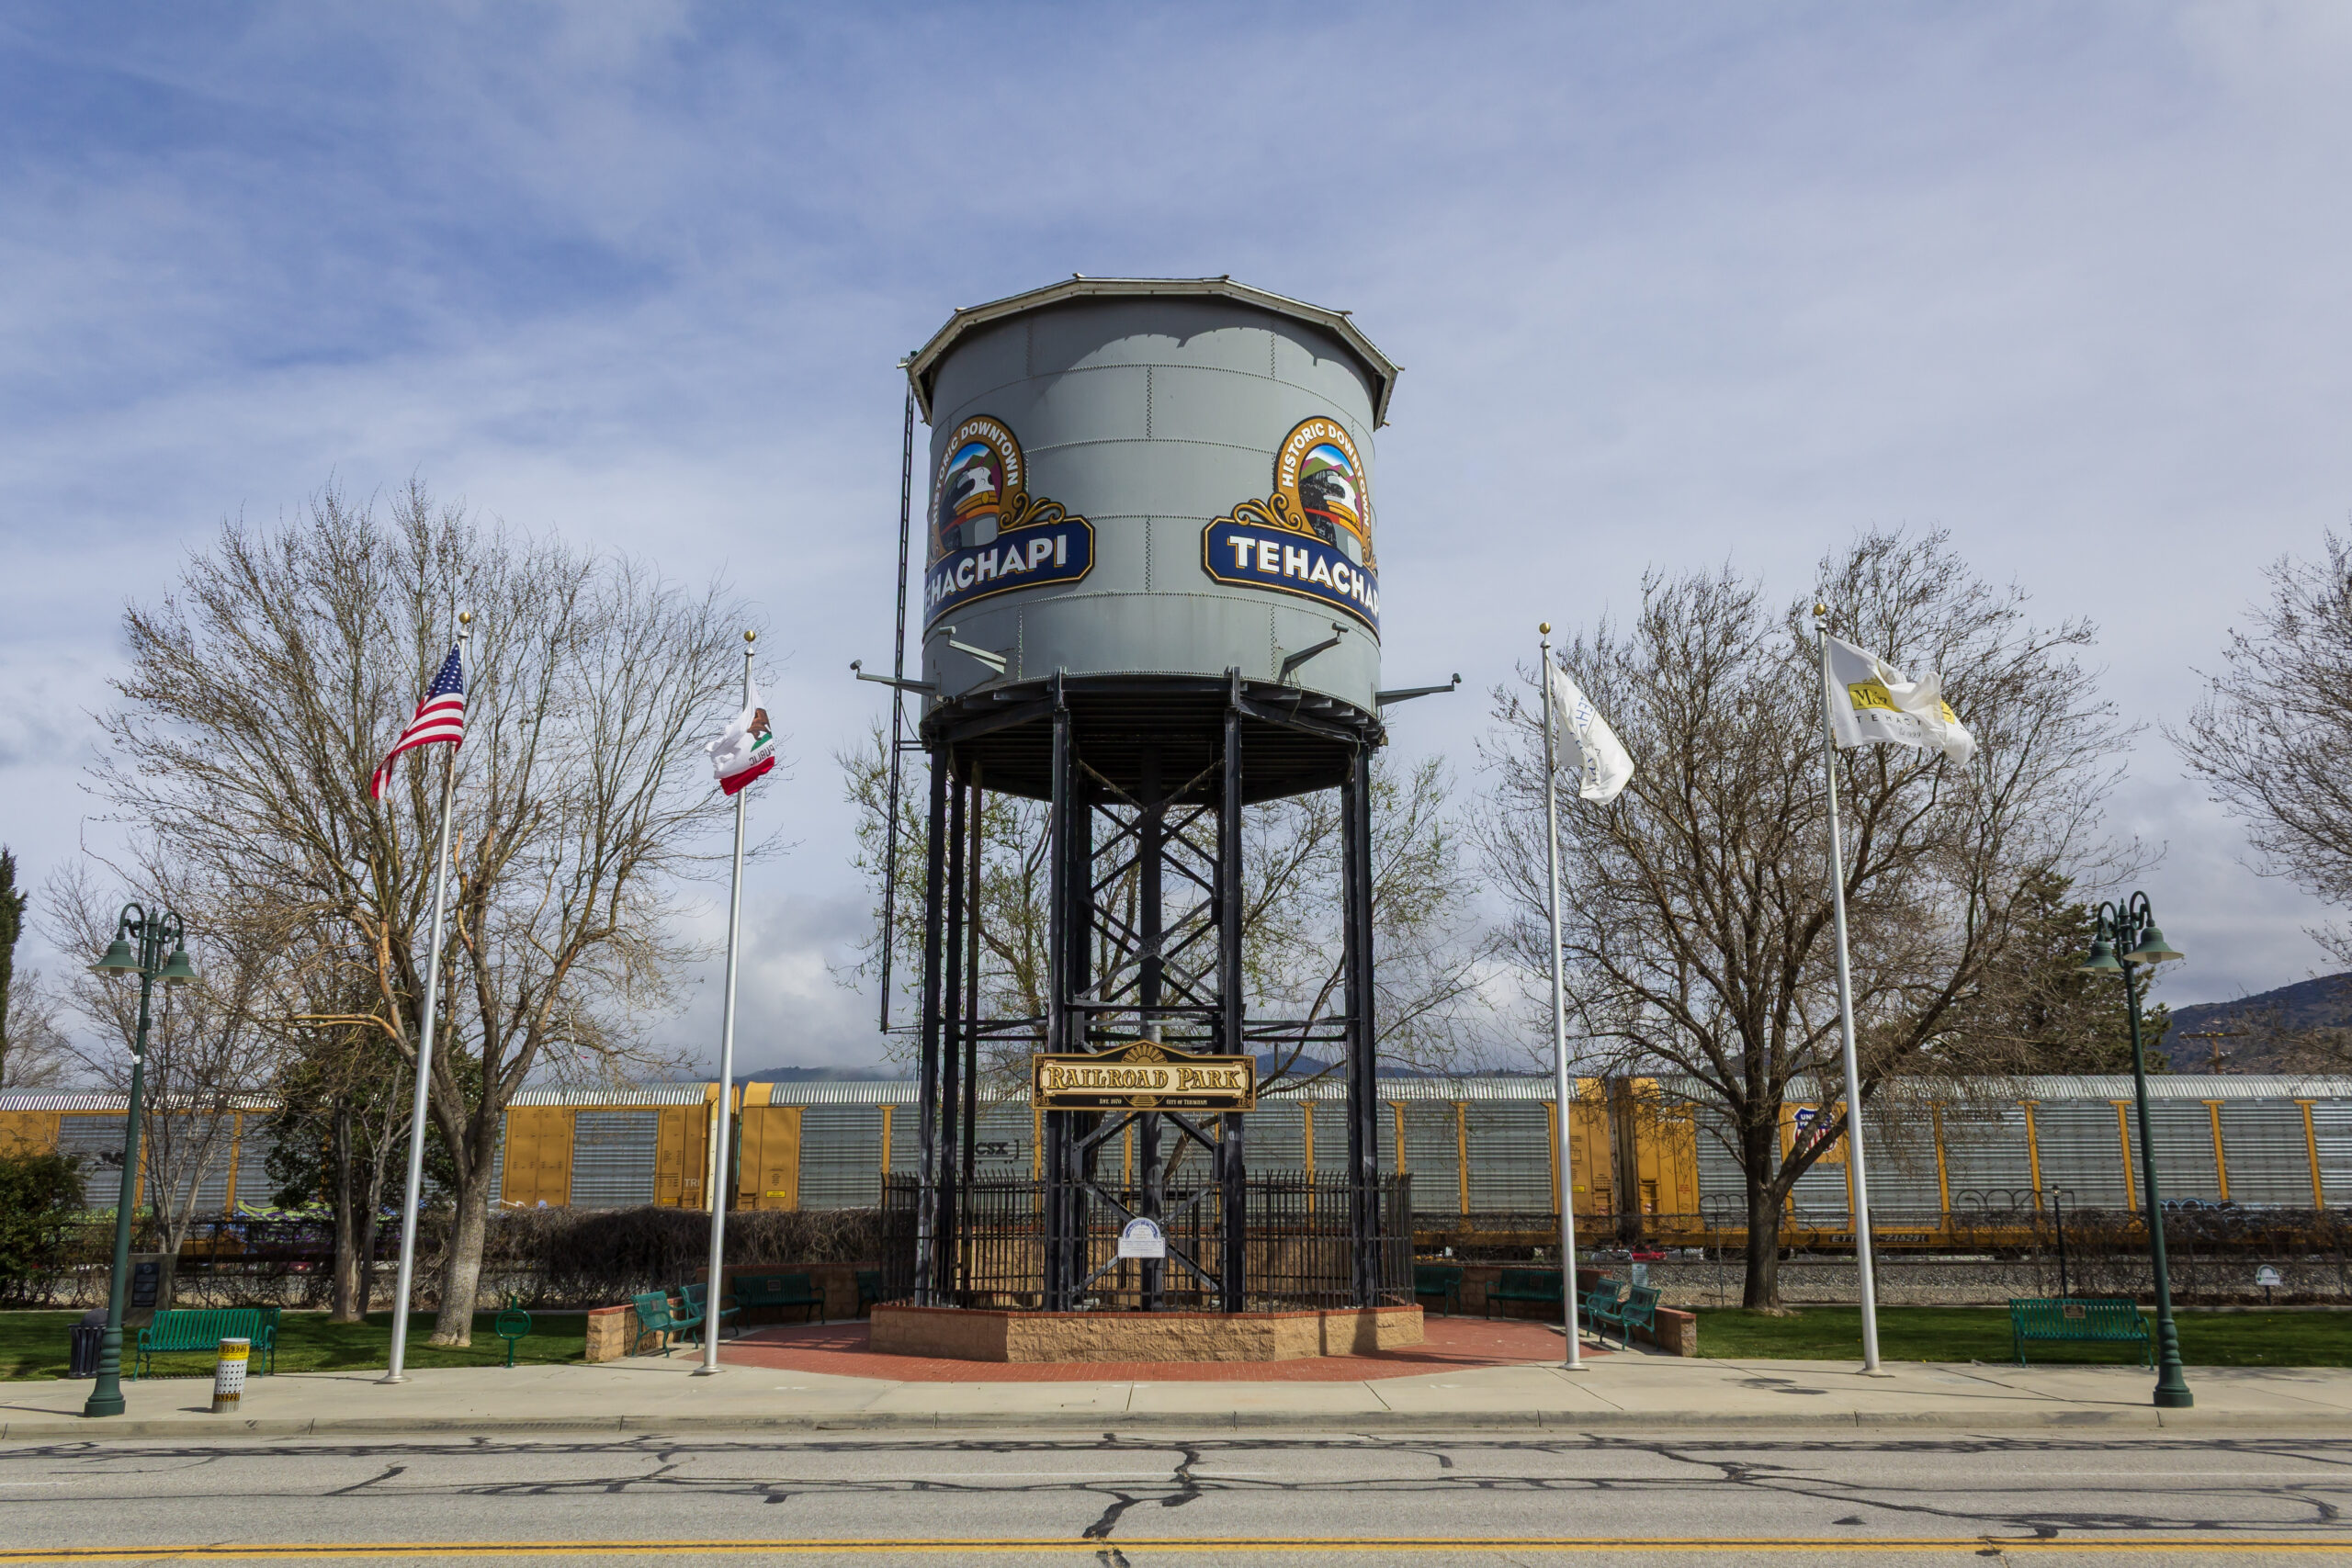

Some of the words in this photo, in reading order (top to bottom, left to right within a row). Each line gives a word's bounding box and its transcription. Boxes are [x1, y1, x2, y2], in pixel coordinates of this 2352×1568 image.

[960, 421, 1019, 487] DOWNTOWN
[1282, 423, 1325, 489] HISTORIC
[1328, 423, 1370, 527] DOWNTOWN
[925, 535, 1068, 613] EHACHAPI
[1228, 535, 1379, 619] TEHACHAP
[1046, 1066, 1169, 1090] RAILROAD
[1176, 1066, 1241, 1091] PARK
[975, 1142, 1009, 1156] CSX
